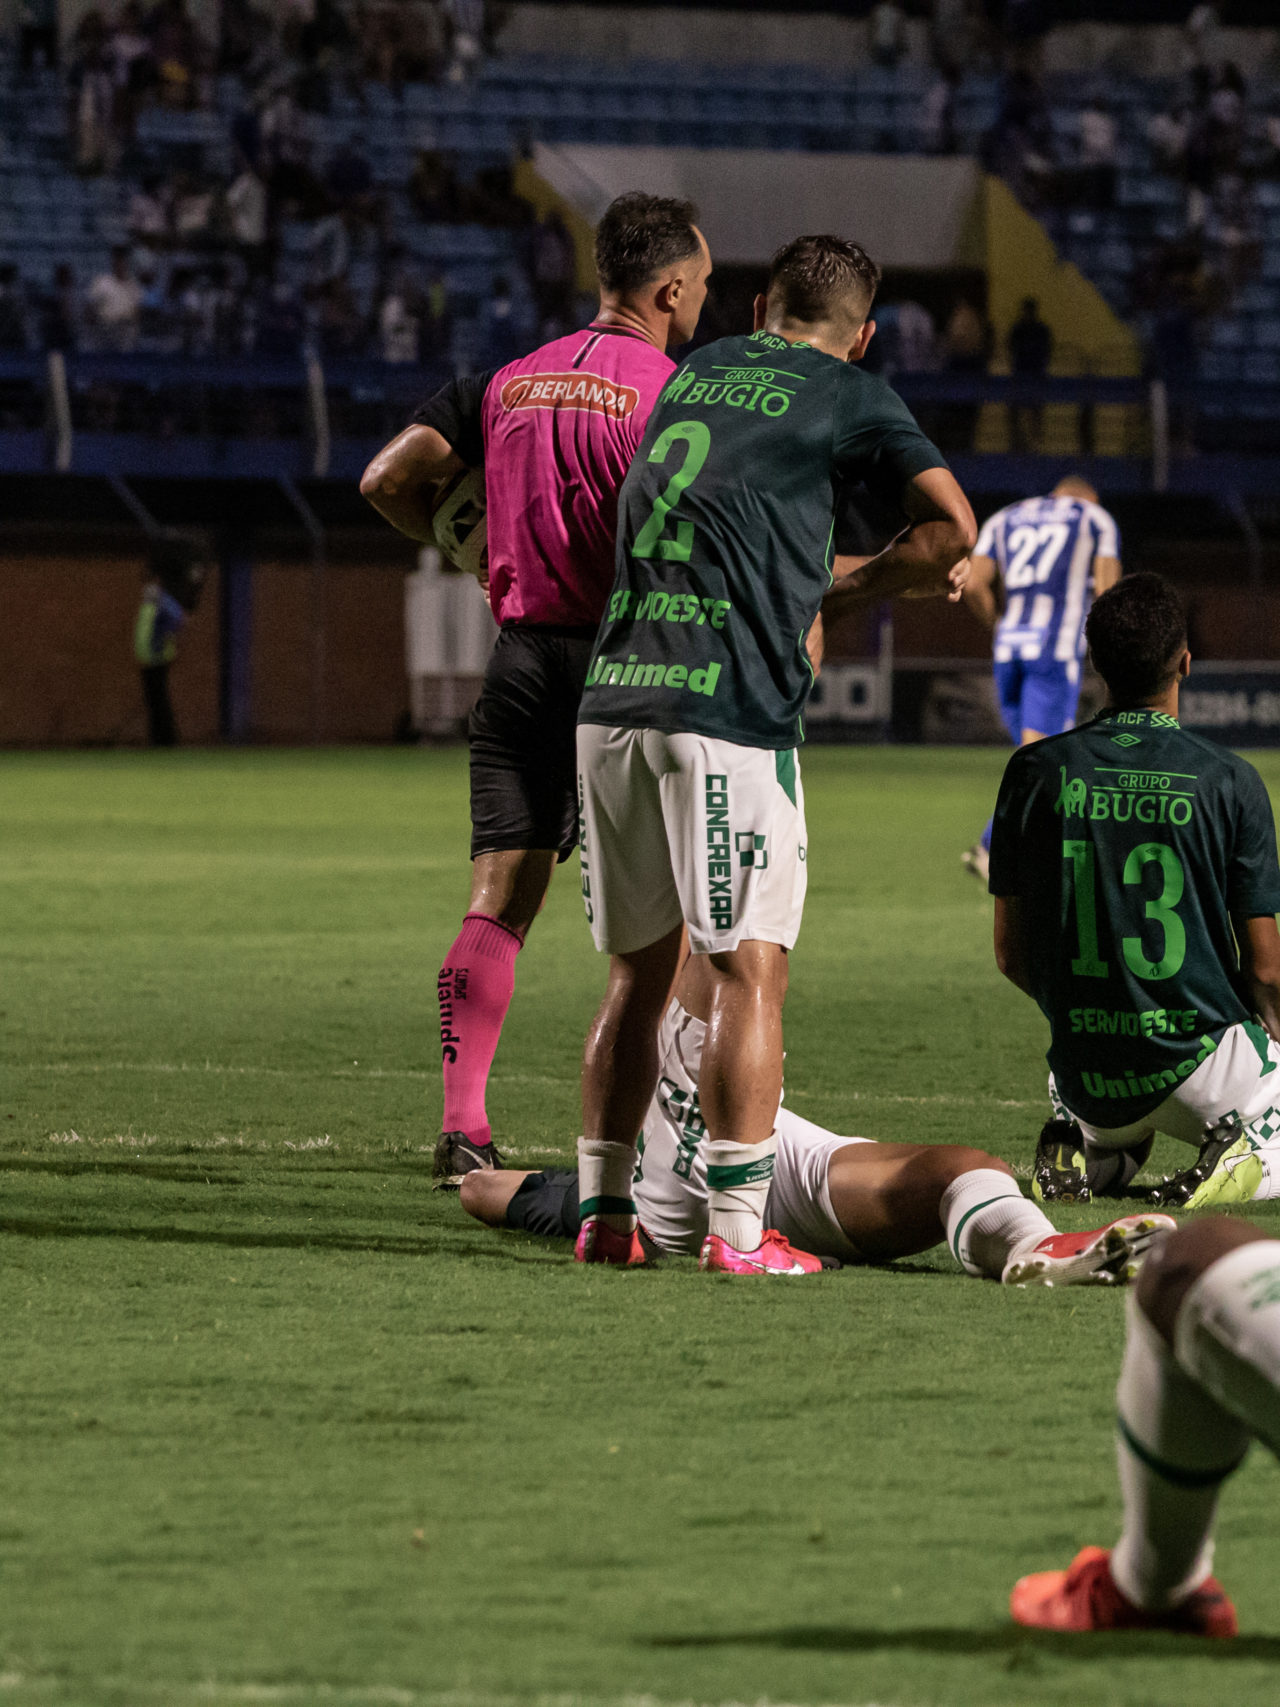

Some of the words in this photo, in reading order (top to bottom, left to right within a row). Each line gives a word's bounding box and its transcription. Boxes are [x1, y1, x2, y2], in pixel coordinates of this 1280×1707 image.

[761, 336, 788, 351] ACF
[724, 370, 776, 383] GRUPO
[528, 380, 627, 412] BERLANDA
[681, 383, 790, 417] BUGIO
[631, 420, 711, 562] 2
[1005, 524, 1070, 588] 27
[585, 654, 722, 697] Unimed
[1117, 712, 1146, 725] ACF
[1118, 774, 1171, 790] GRUPO
[1090, 791, 1193, 826] BUGIO
[705, 774, 732, 931] CONCREXAP
[1062, 840, 1187, 981] 13
[1068, 1008, 1199, 1038] SERVIOESTE
[1080, 1034, 1219, 1099] Unimed
